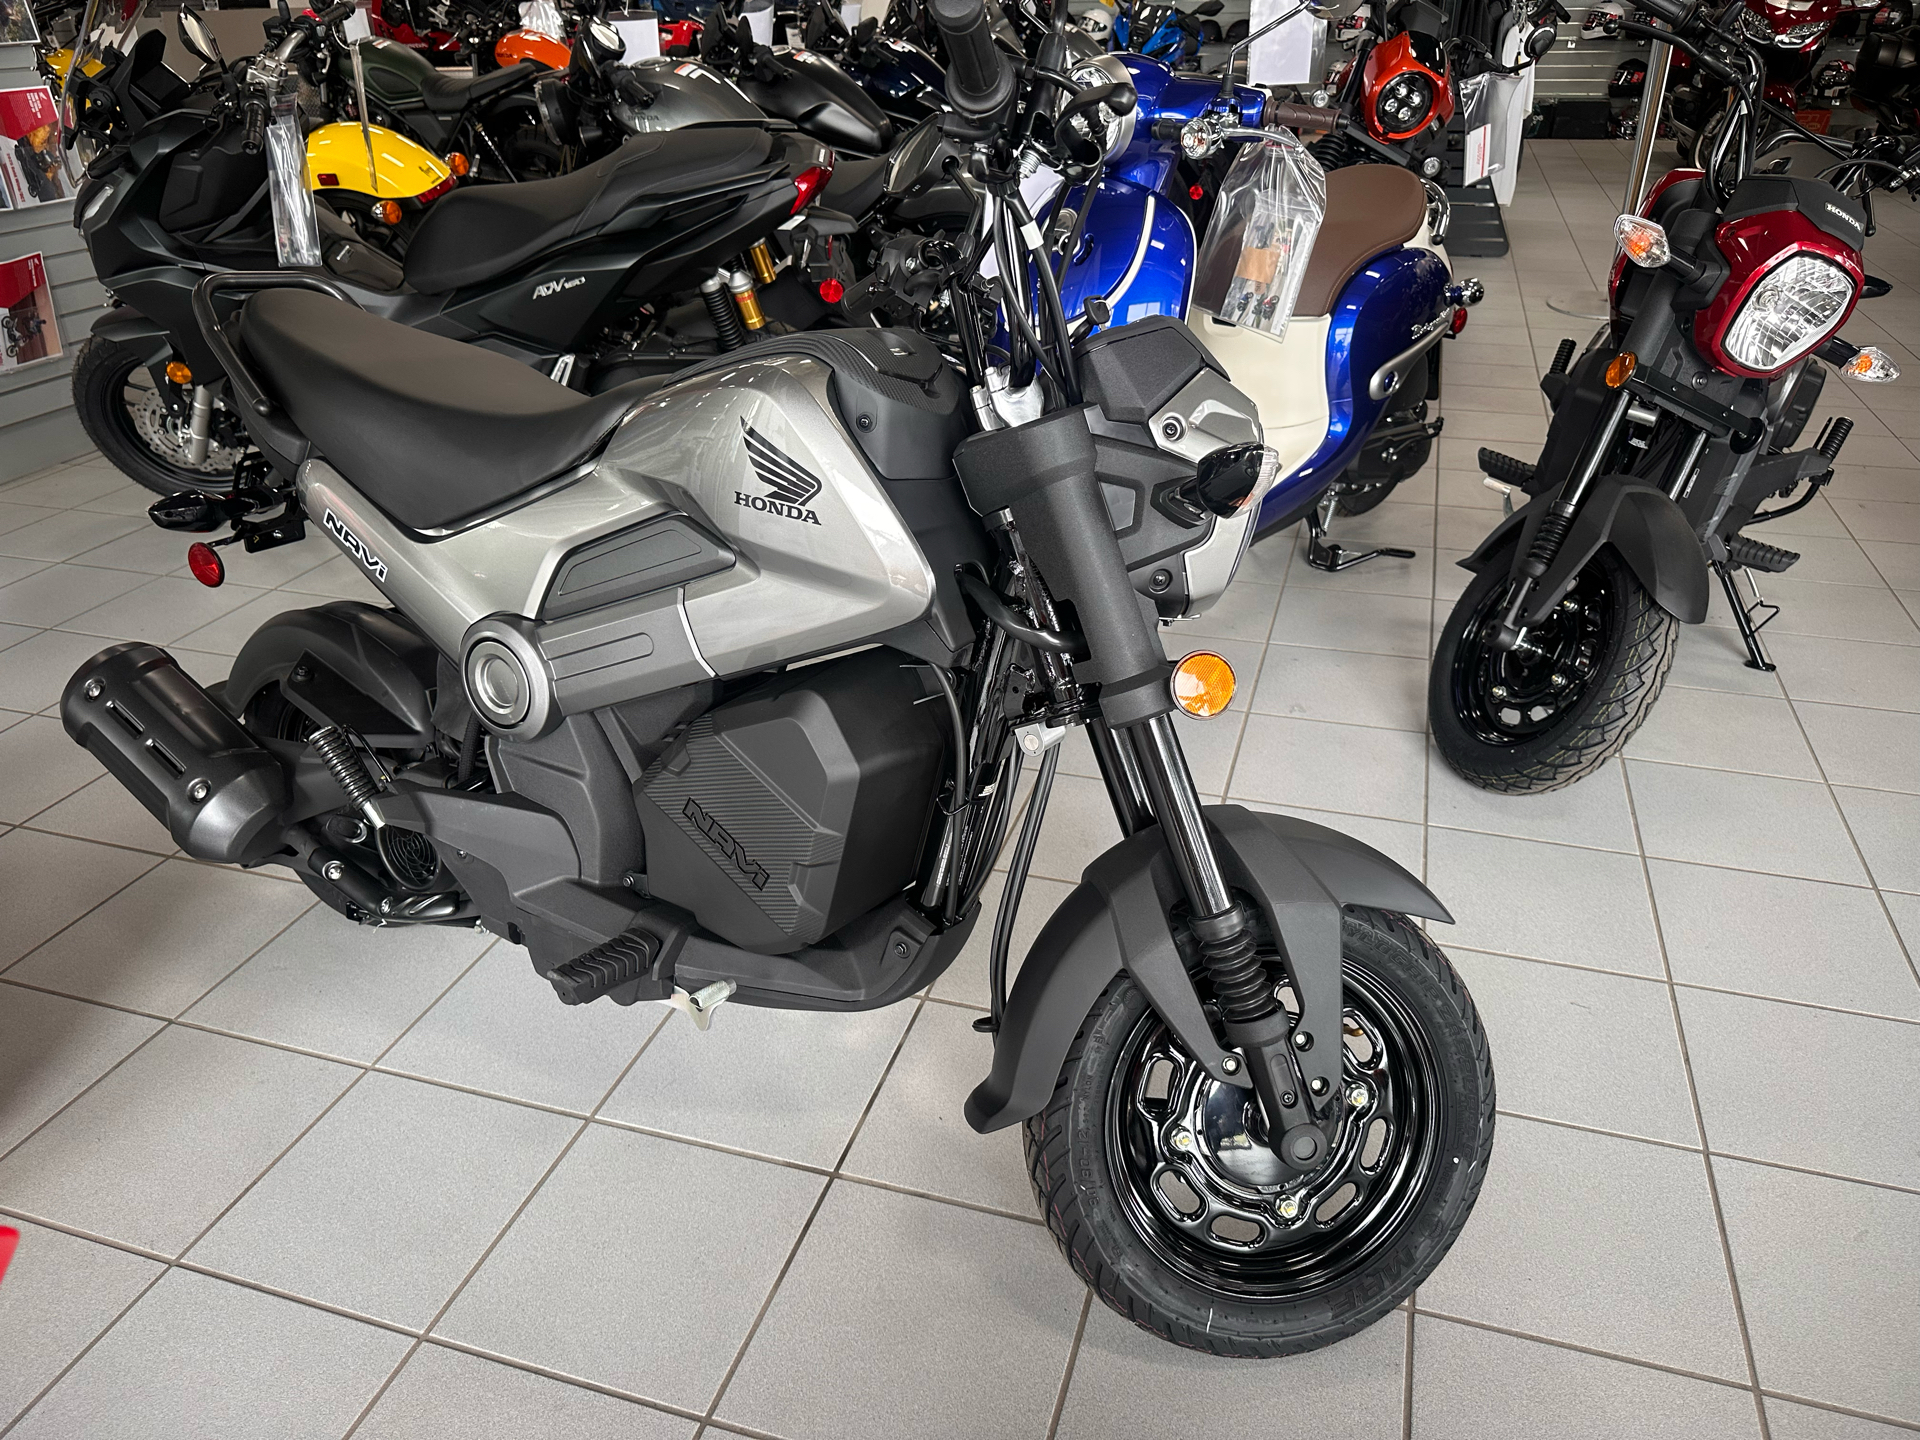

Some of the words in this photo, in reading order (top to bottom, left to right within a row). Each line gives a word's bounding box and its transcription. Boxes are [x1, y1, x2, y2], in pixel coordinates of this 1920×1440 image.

[1825, 203, 1861, 231] HONDA
[532, 276, 566, 300] ADV
[733, 490, 822, 526] HONDA
[1433, 1161, 1455, 1204] TUBELESS
[1328, 1244, 1420, 1320] MRF
